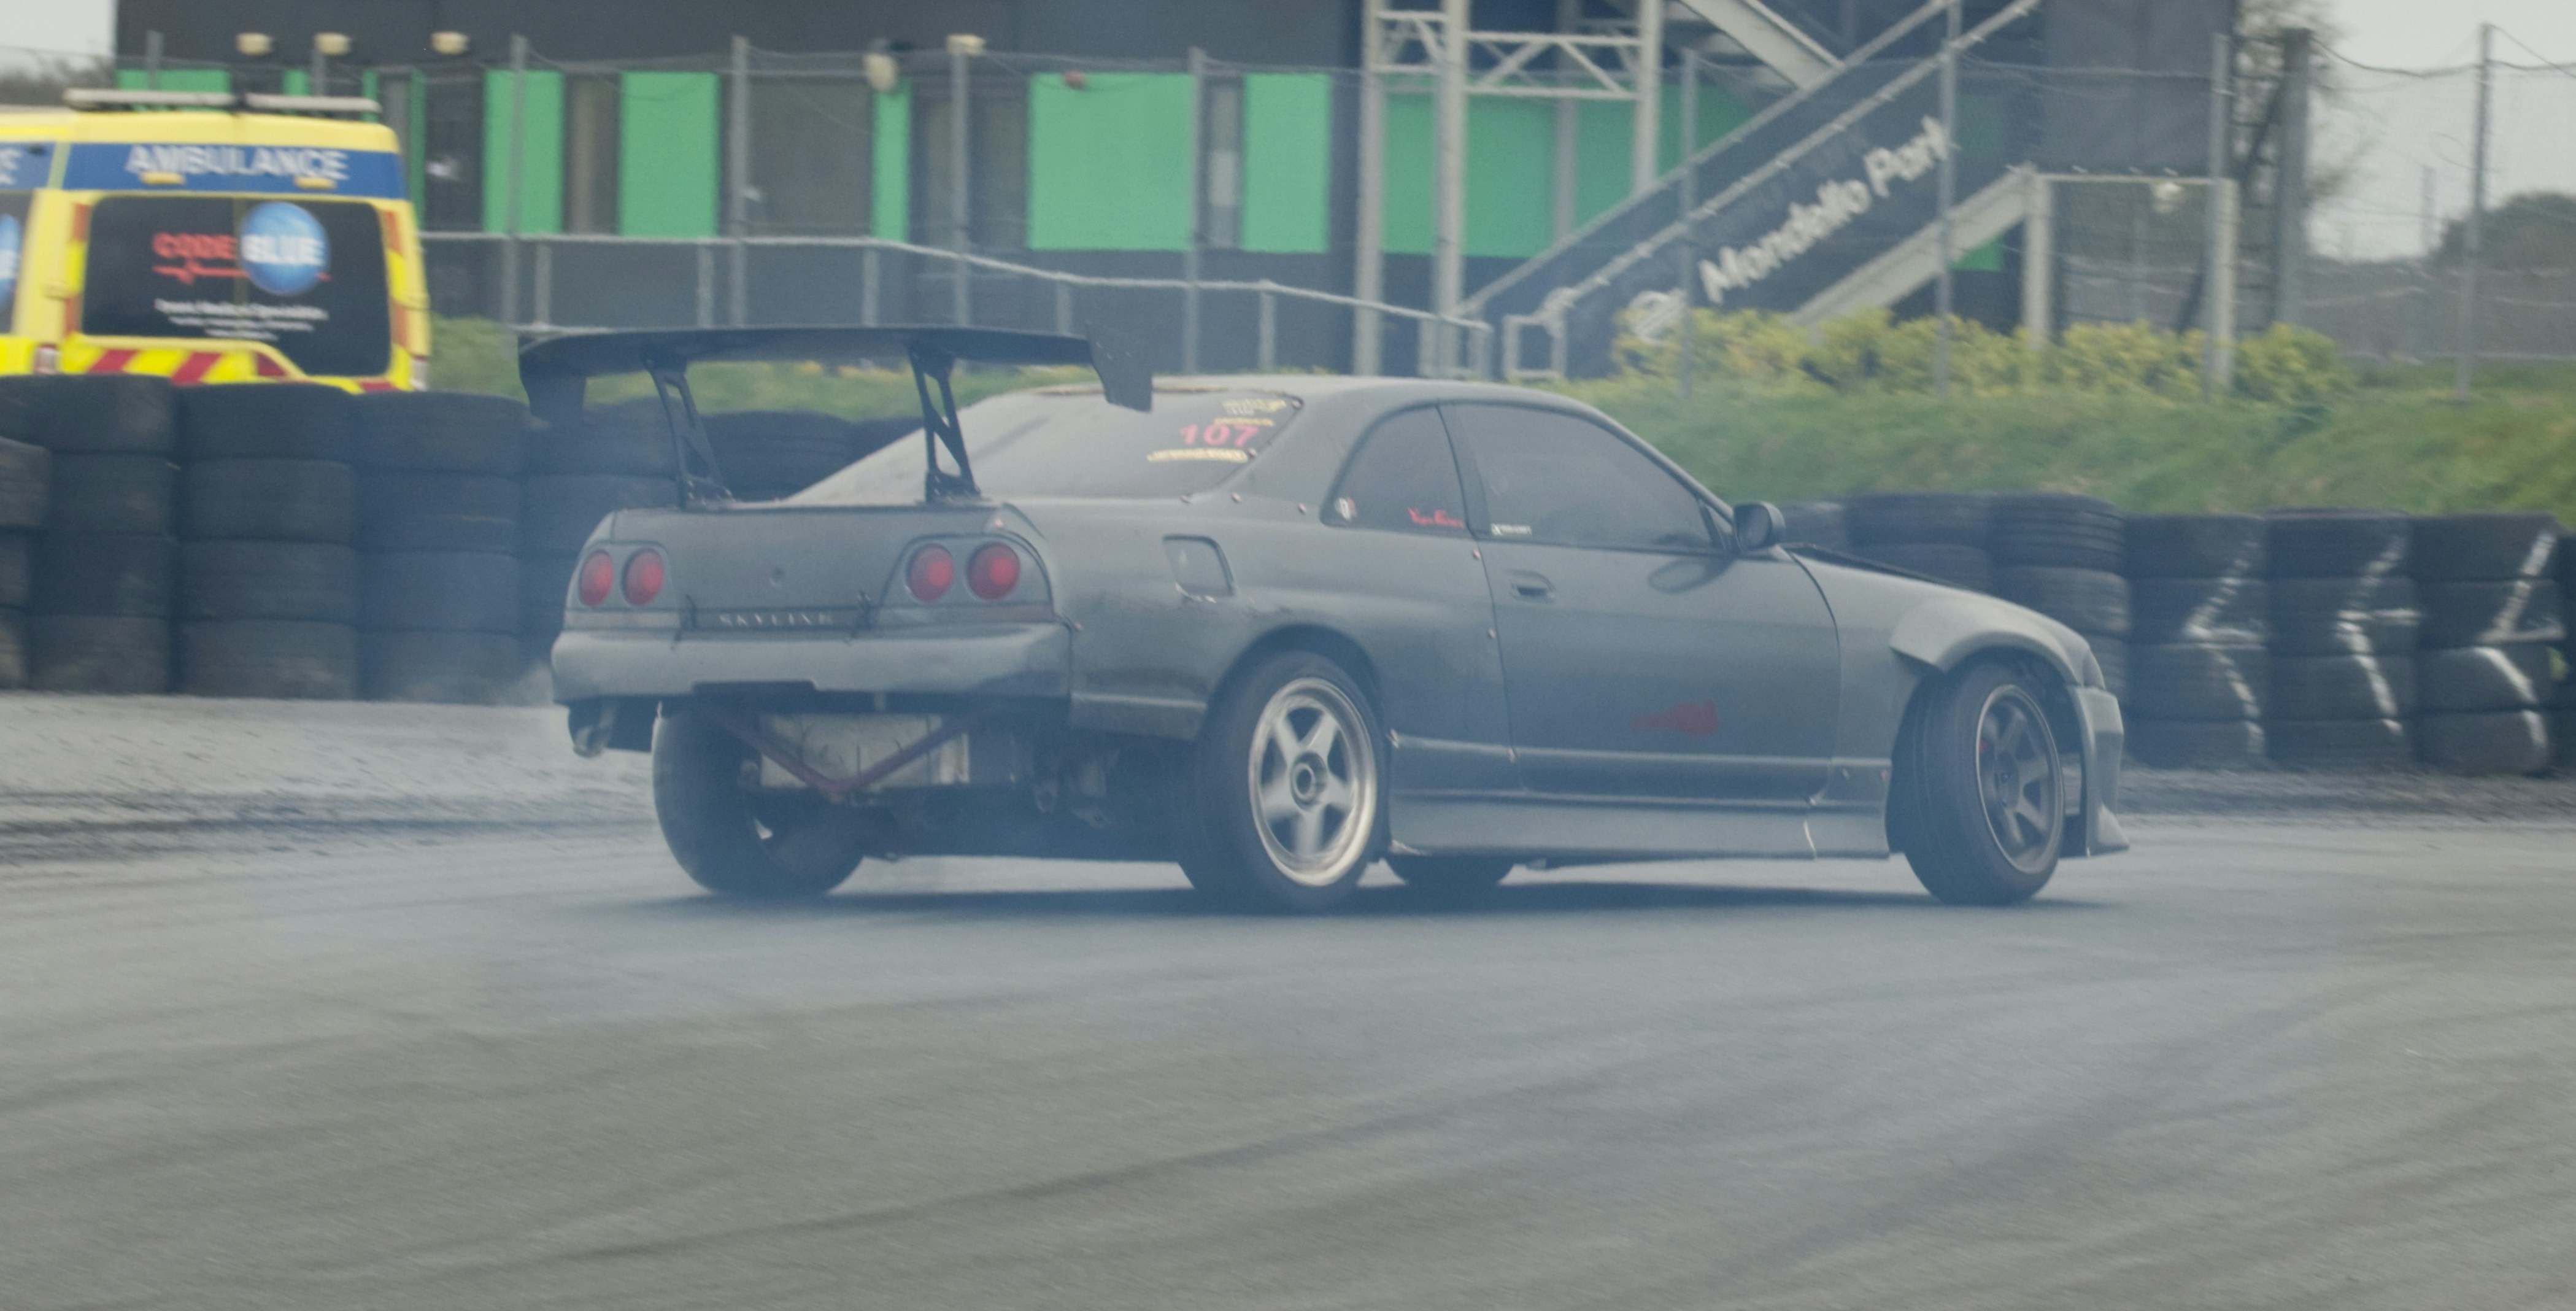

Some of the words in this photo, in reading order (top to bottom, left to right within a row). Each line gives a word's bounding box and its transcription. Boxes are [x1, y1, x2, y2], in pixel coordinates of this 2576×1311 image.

[126, 145, 348, 180] AMBULANCE
[1699, 180, 1873, 303] Mondello
[1864, 115, 1960, 198] Park
[153, 233, 235, 260] CODE
[241, 234, 325, 266] BLUE
[1181, 424, 1259, 446] 107
[719, 613, 833, 627] SKYLINE
